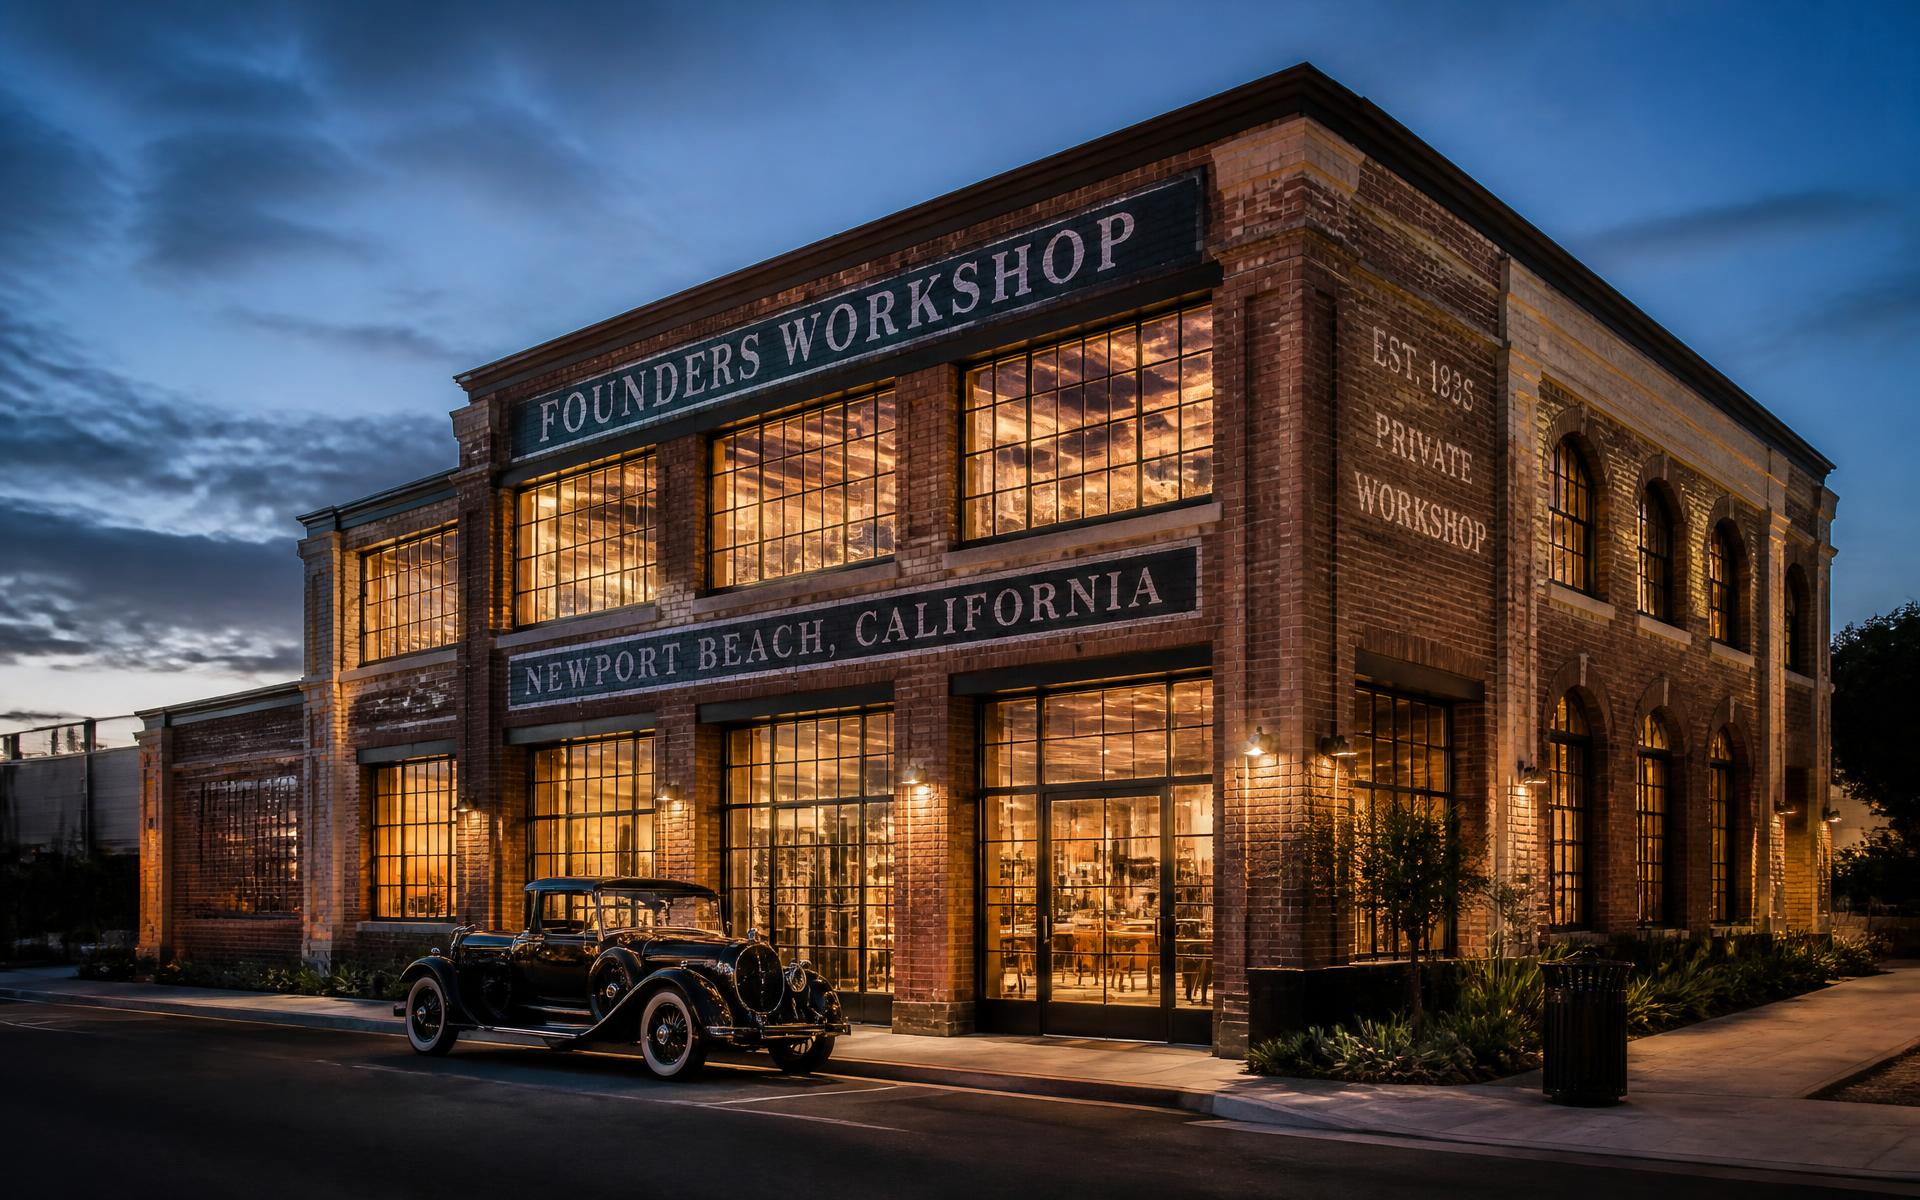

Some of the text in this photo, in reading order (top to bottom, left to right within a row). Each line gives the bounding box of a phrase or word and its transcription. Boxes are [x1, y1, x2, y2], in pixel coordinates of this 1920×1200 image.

[539, 212, 1135, 442] FOUNDERS WORKSHOP
[1373, 326, 1420, 385] EST.
[1375, 412, 1473, 485] PRIVATE
[1354, 471, 1487, 554] WORKSHOP
[526, 566, 1163, 696] NEWPORT BEACH, CALIFORNIA
